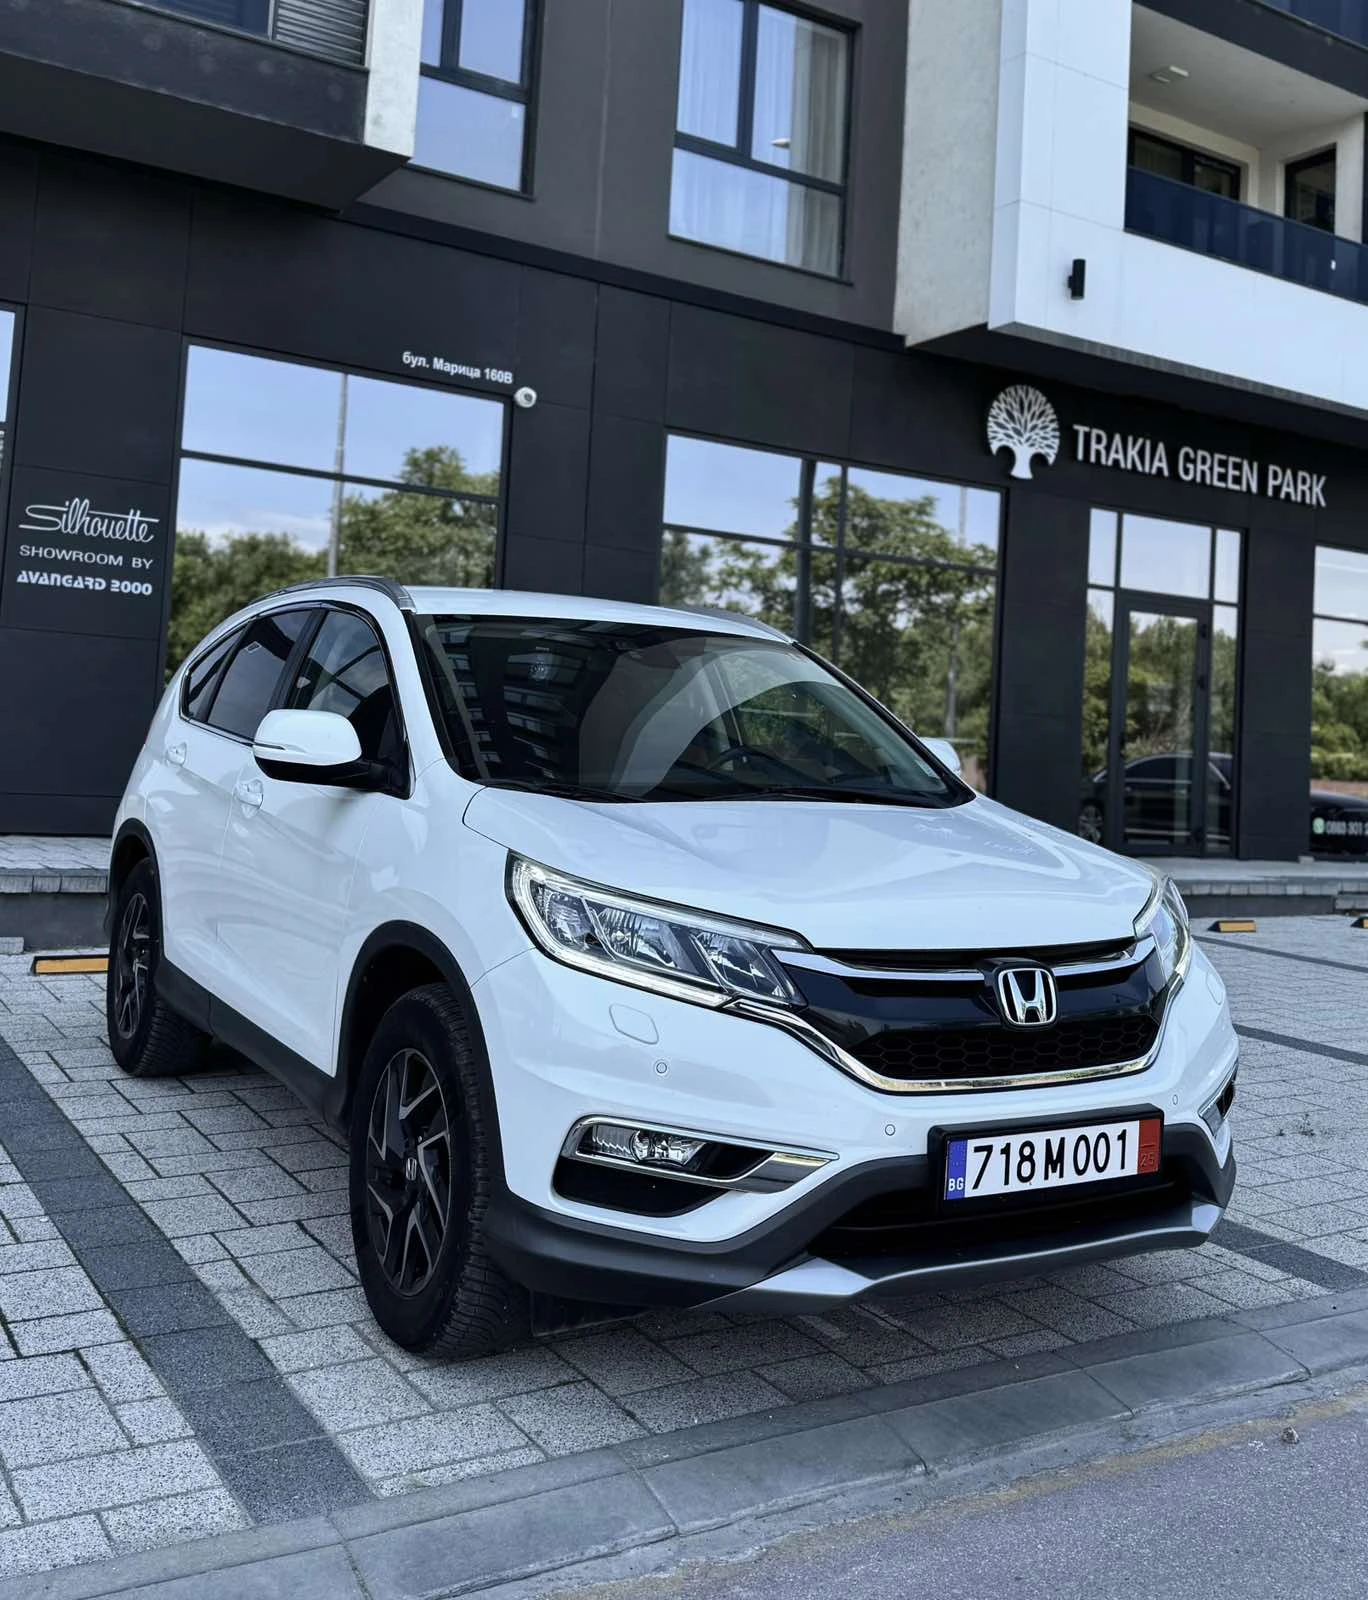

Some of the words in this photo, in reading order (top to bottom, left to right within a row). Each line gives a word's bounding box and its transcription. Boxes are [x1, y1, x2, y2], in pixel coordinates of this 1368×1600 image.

[402, 351, 430, 368] бул.
[433, 357, 481, 379] Марица
[1073, 424, 1169, 477] TRAKIA
[1177, 446, 1258, 494] GREEN
[1267, 465, 1327, 508] PARK
[18, 498, 159, 543] Silhouette
[19, 545, 123, 566] SHOWROOM
[131, 557, 153, 569] BY
[17, 570, 106, 590] AVANGARD
[110, 579, 153, 595] 2000
[972, 1129, 1127, 1190] 718M001
[948, 1177, 964, 1191] BG
